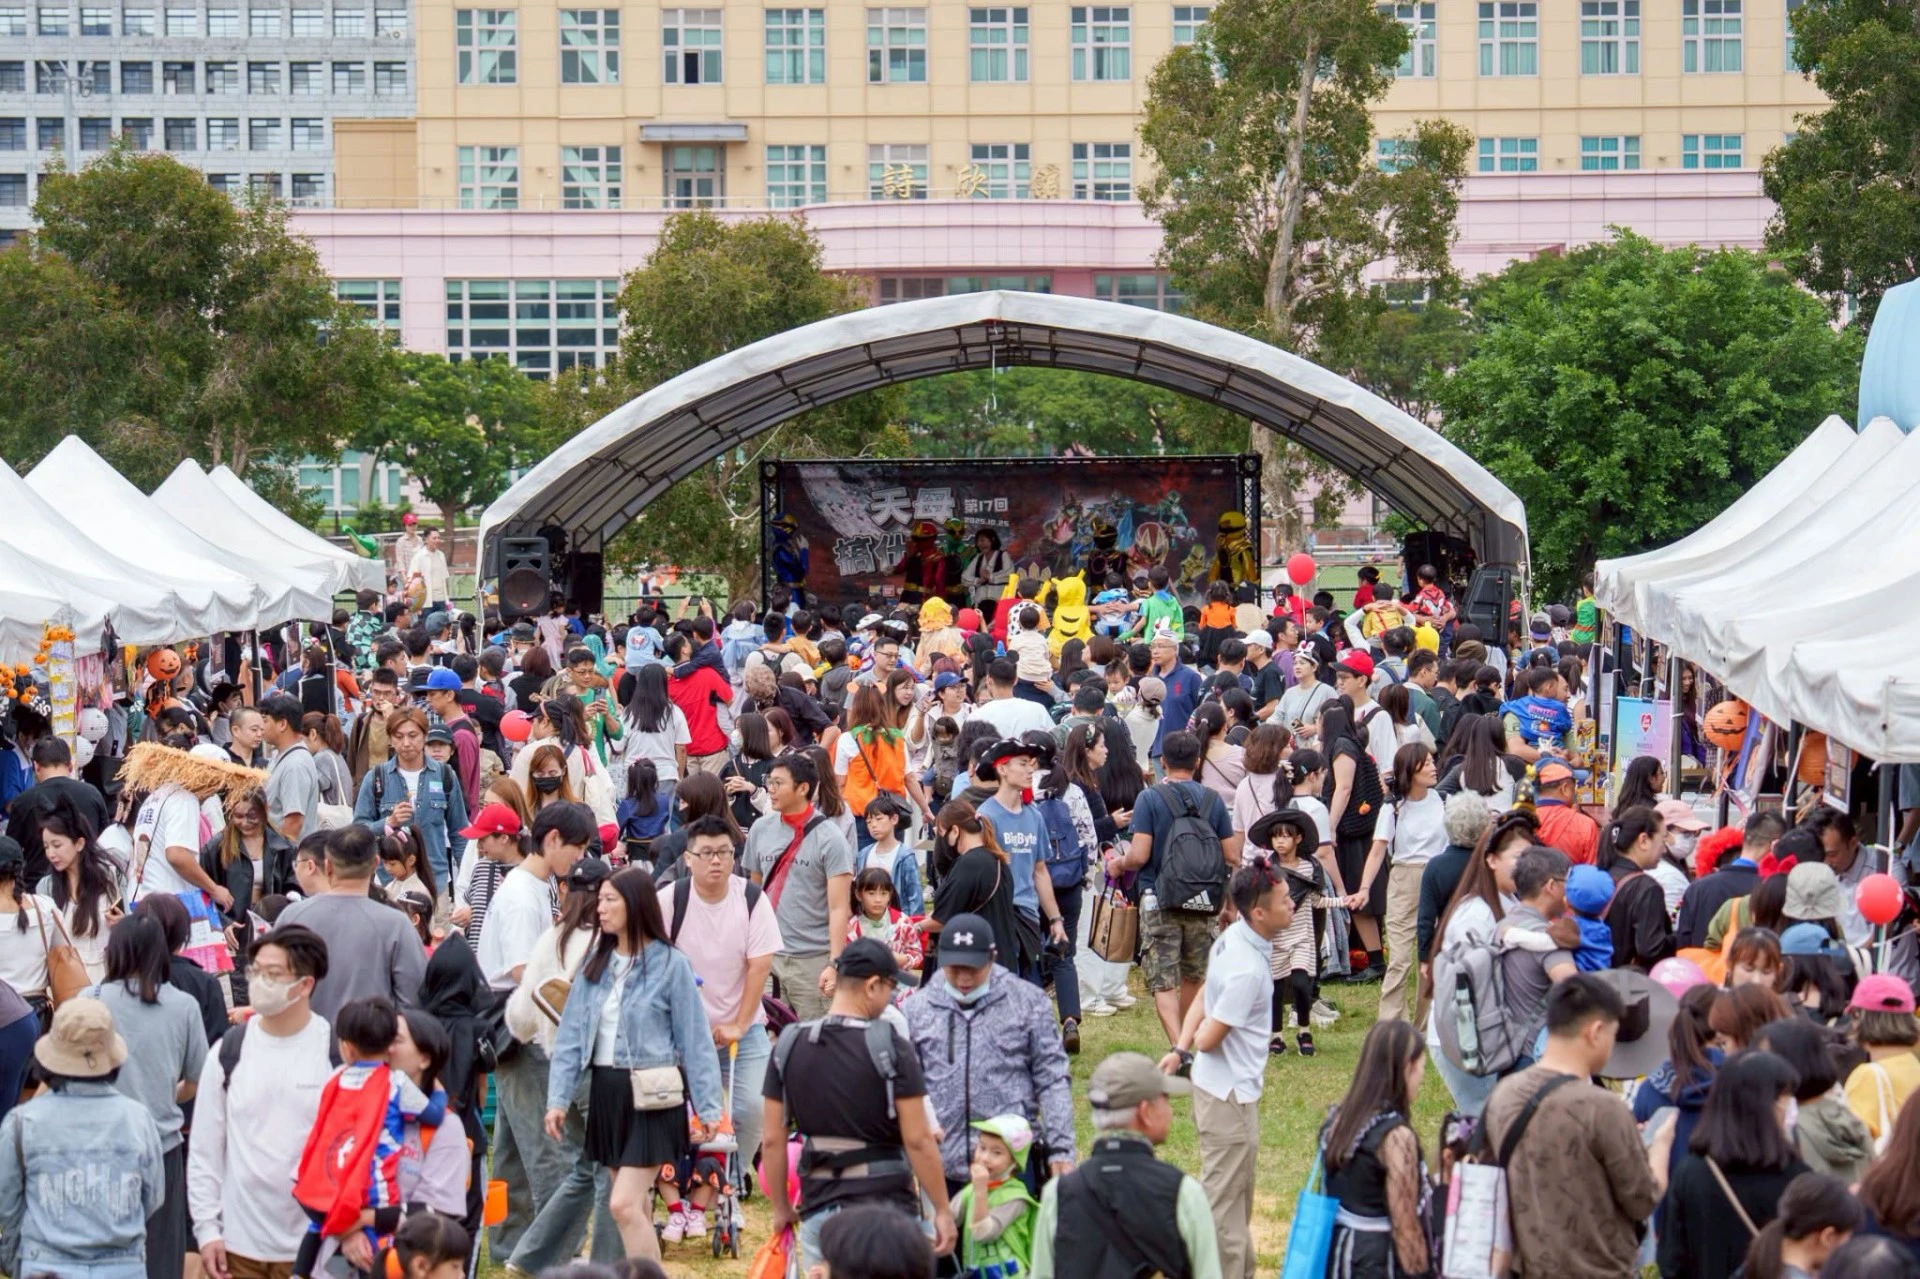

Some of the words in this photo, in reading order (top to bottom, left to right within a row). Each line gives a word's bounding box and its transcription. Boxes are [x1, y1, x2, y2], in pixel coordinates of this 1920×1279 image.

[871, 487, 955, 525] 天母
[964, 497, 1009, 513] 第17回
[964, 516, 1010, 528] 2025.10.25
[1182, 902, 1214, 911] adidas
